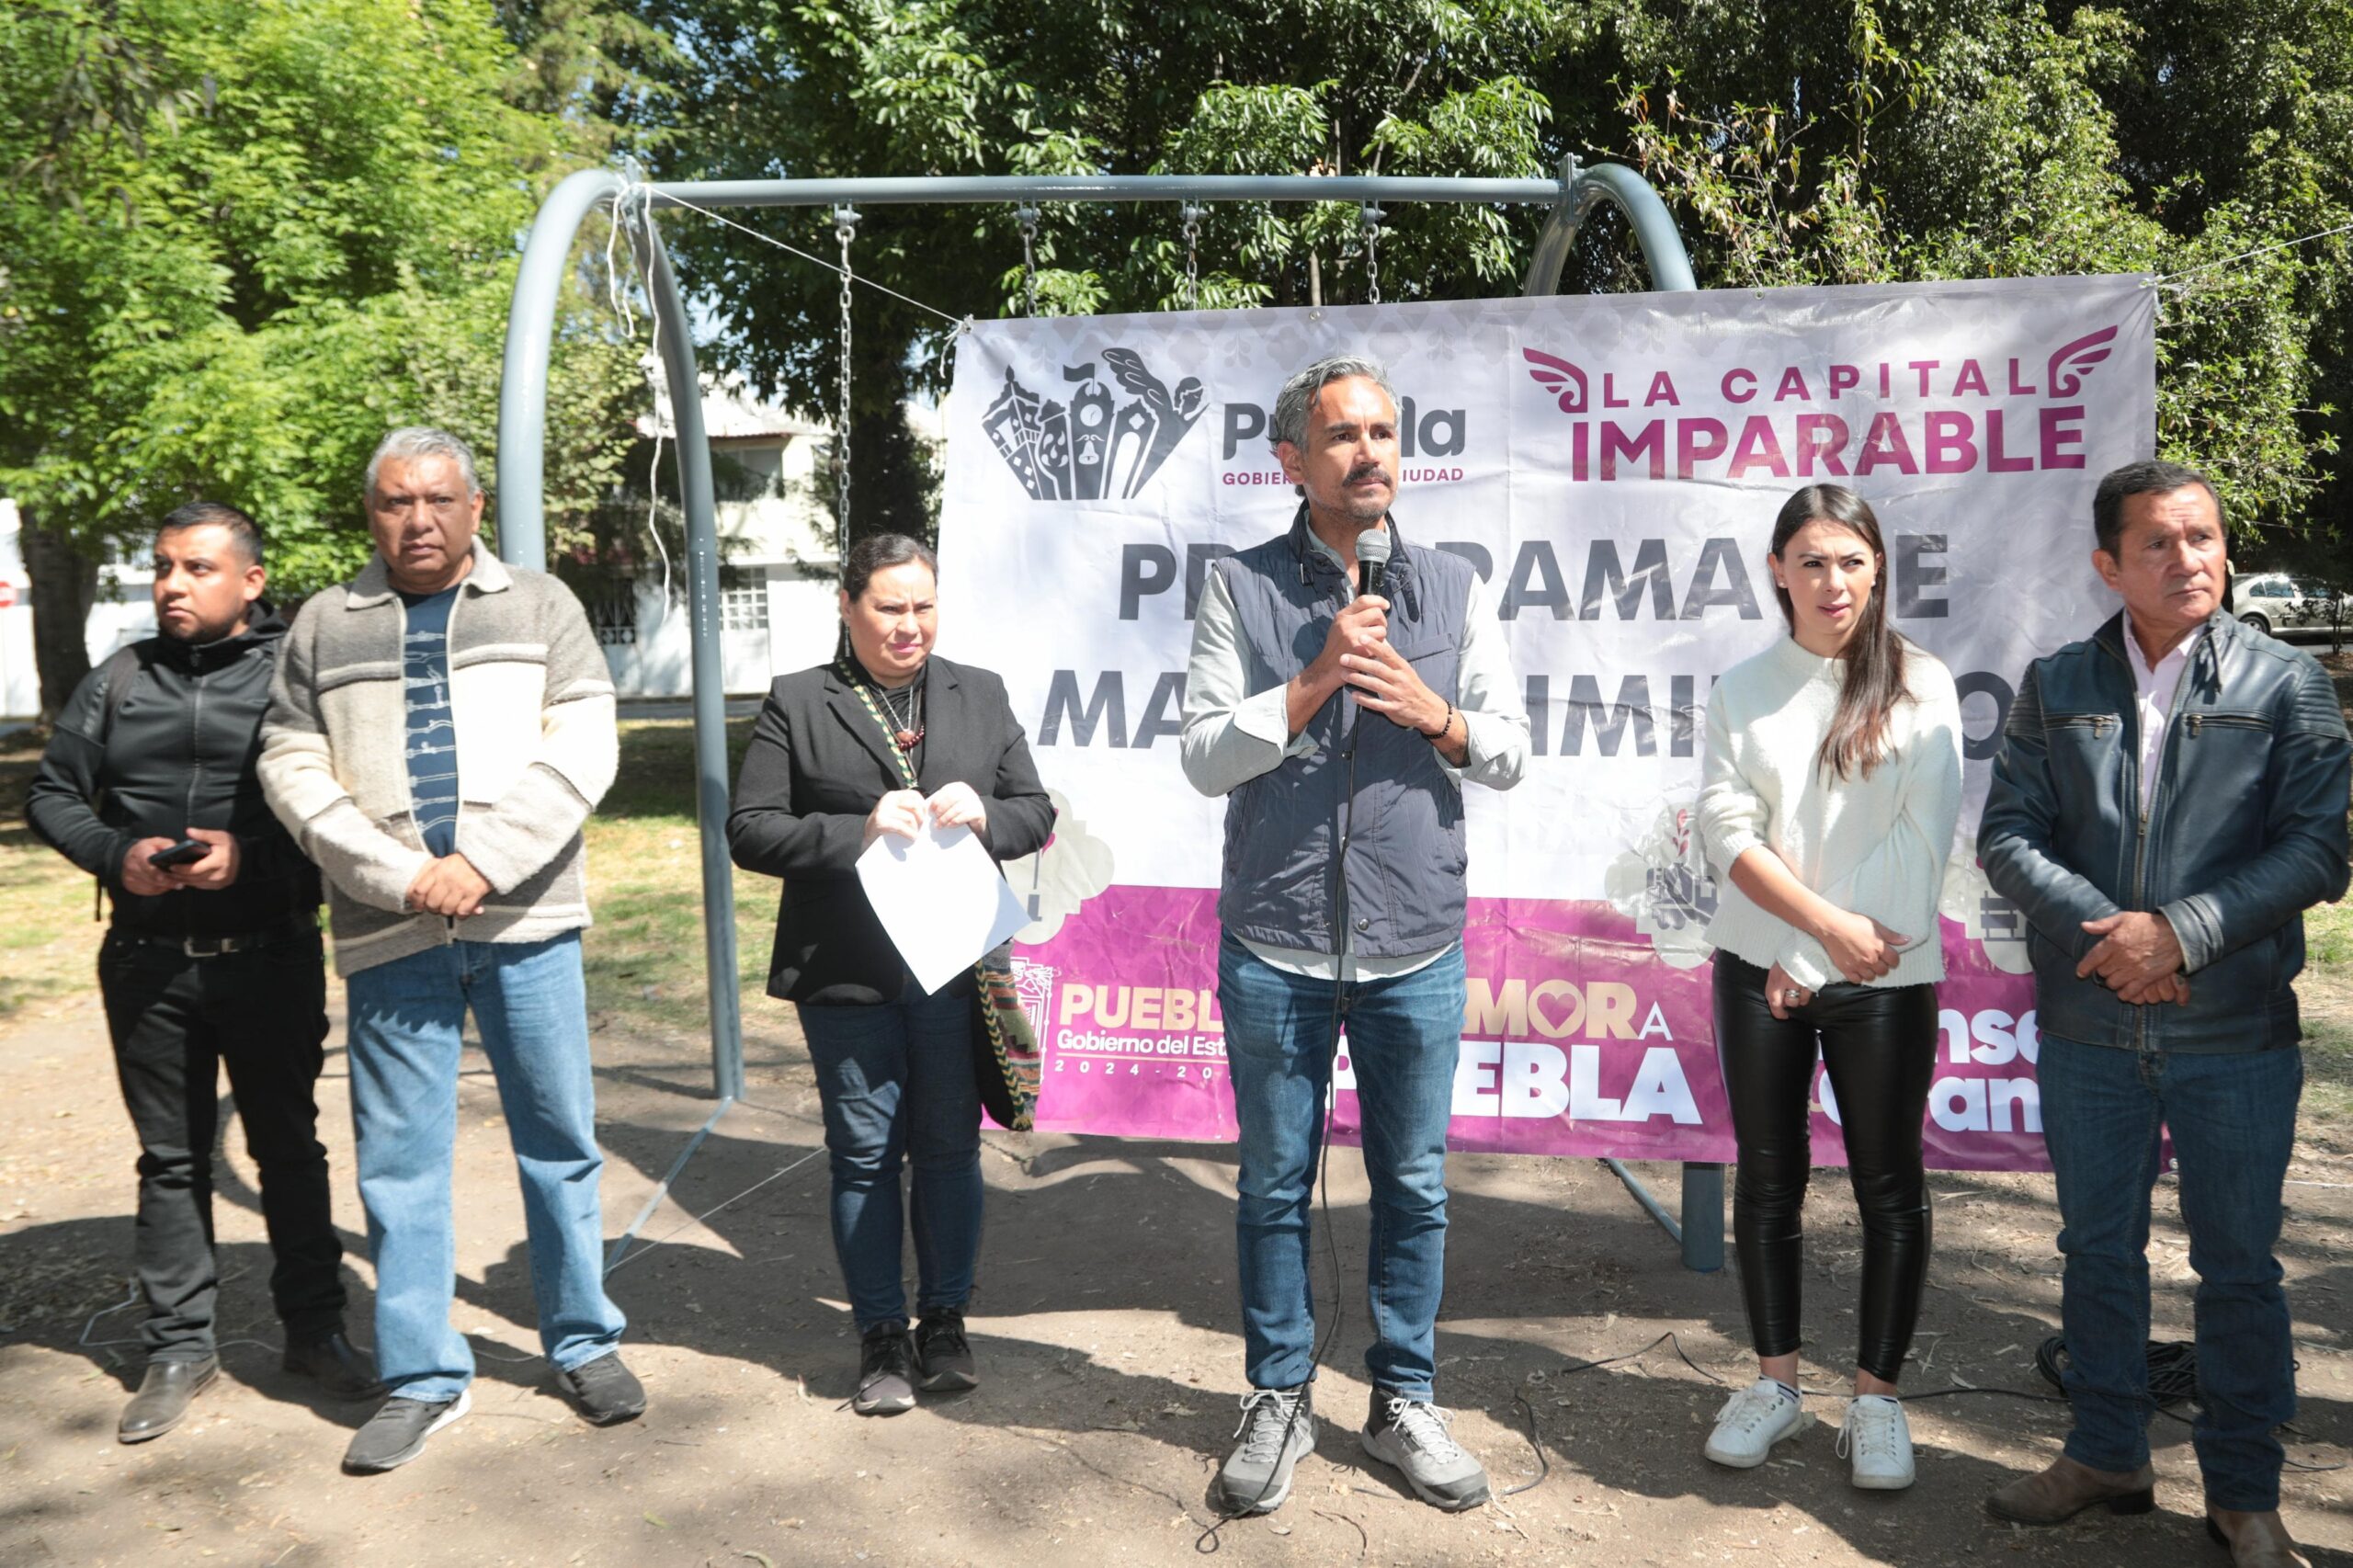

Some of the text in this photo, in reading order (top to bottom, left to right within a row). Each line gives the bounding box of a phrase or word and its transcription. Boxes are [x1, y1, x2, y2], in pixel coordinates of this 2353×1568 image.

[1604, 358, 2036, 408] LA CAPITAL
[1222, 396, 1466, 460] Pla
[1573, 404, 2086, 482] IMPARABLE
[1222, 468, 1463, 486] GOBIER IUDAD
[1895, 534, 1949, 619] E
[1059, 983, 1224, 1032] PUEBL
[1461, 977, 1674, 1041] MOR A
[1054, 1060, 1212, 1080] 2024-20
[1057, 1028, 1228, 1057] Gobierno del Est
[1324, 1035, 1703, 1125] EBLA
